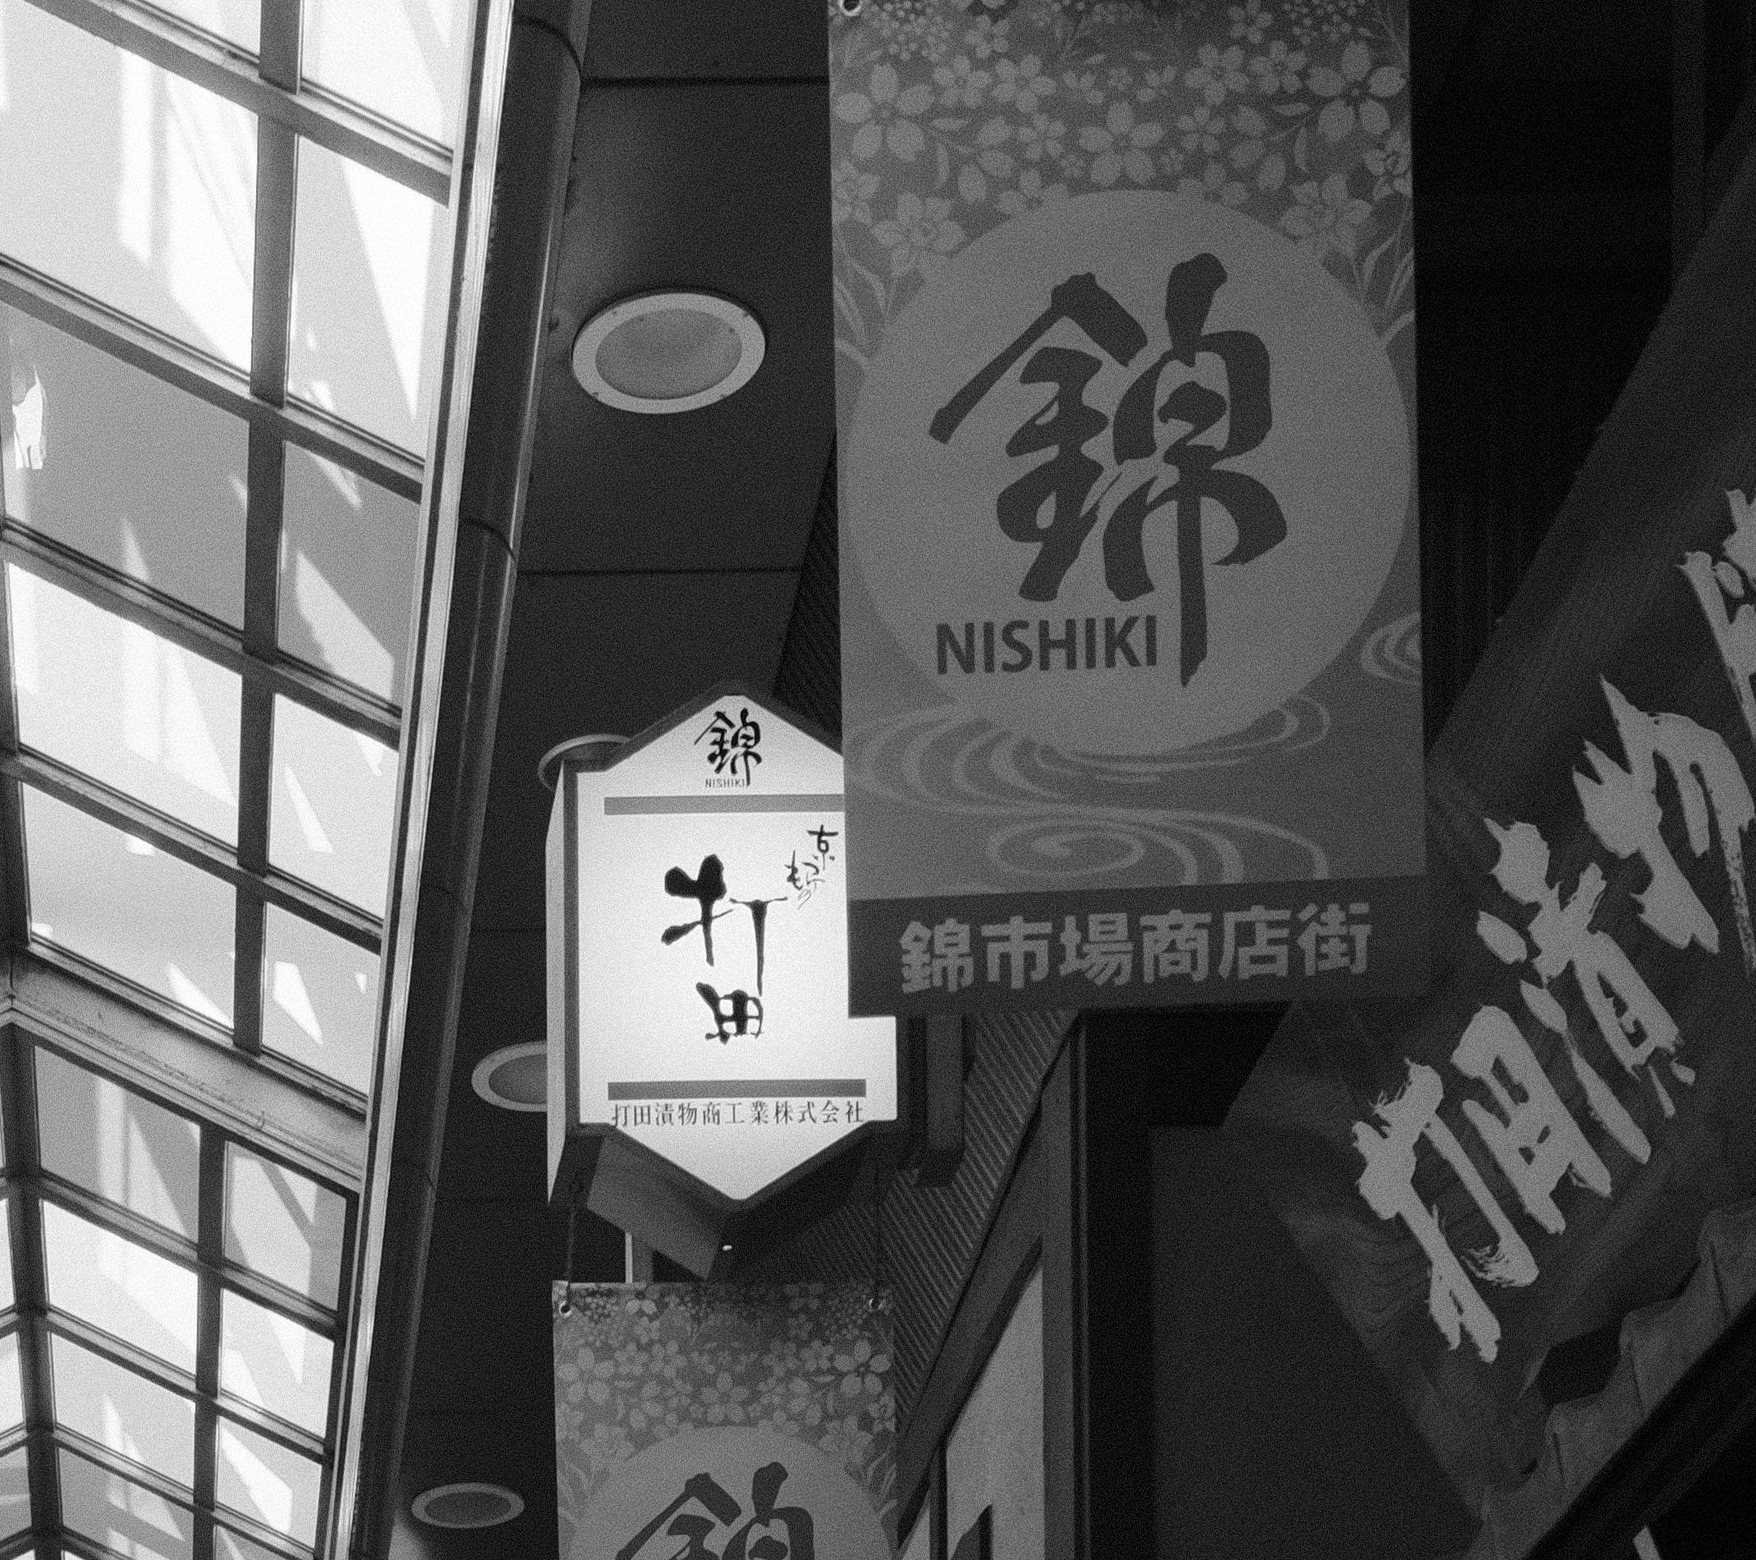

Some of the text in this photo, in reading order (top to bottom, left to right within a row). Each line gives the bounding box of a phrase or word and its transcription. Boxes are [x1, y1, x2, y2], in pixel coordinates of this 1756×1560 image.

[929, 252, 1288, 688] 錦
[936, 614, 1157, 677] NISHIKI
[695, 708, 763, 785] 錦
[704, 777, 747, 789] NISHIKI
[661, 855, 789, 1045] 打田
[899, 904, 1371, 995] 錦市場商店街
[610, 1101, 863, 1127] 打田漬物商工業株式会社
